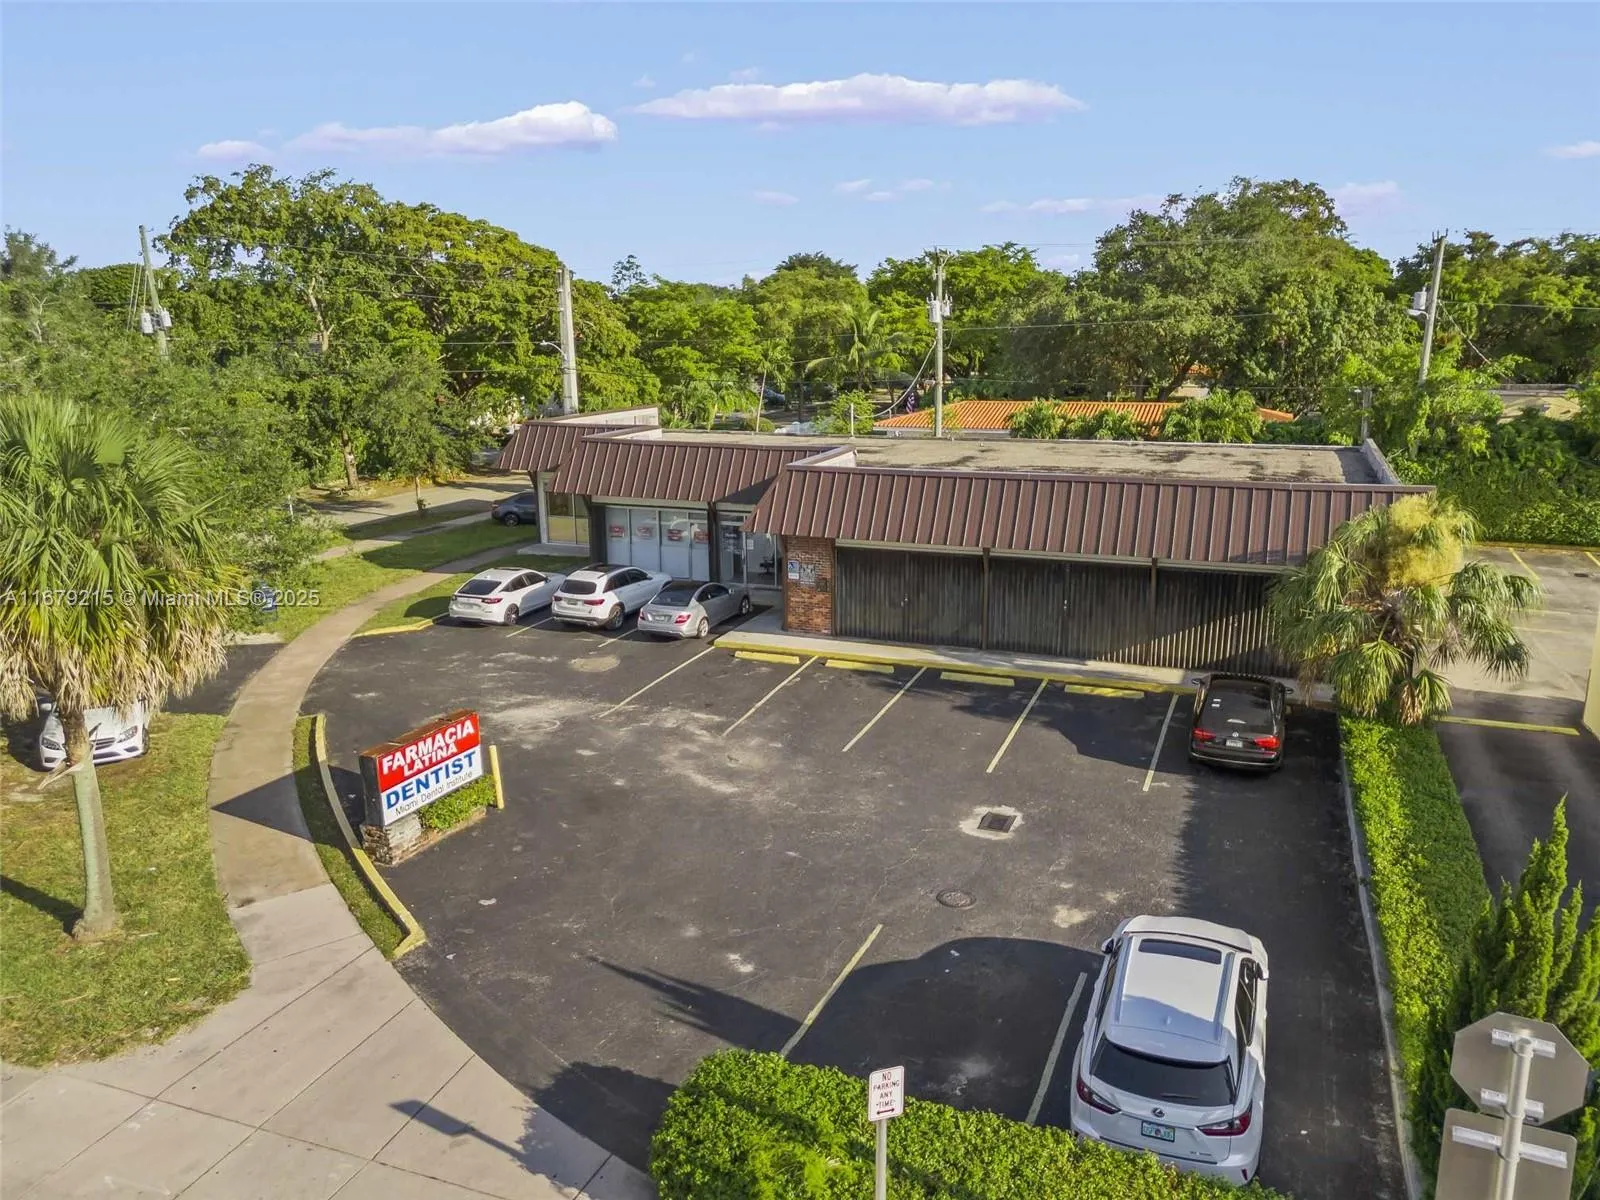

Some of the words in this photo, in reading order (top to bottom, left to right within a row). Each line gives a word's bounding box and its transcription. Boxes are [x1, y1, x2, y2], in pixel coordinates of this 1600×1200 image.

[382, 719, 475, 775] FARMACIA
[403, 743, 458, 777] LATINA
[386, 751, 477, 810] DENTIST
[394, 800, 418, 817] Miami
[421, 785, 445, 802] Dental
[447, 771, 473, 790] Institute
[873, 1080, 900, 1091] PARKING
[882, 1072, 892, 1081] NO
[879, 1091, 893, 1099] ANY
